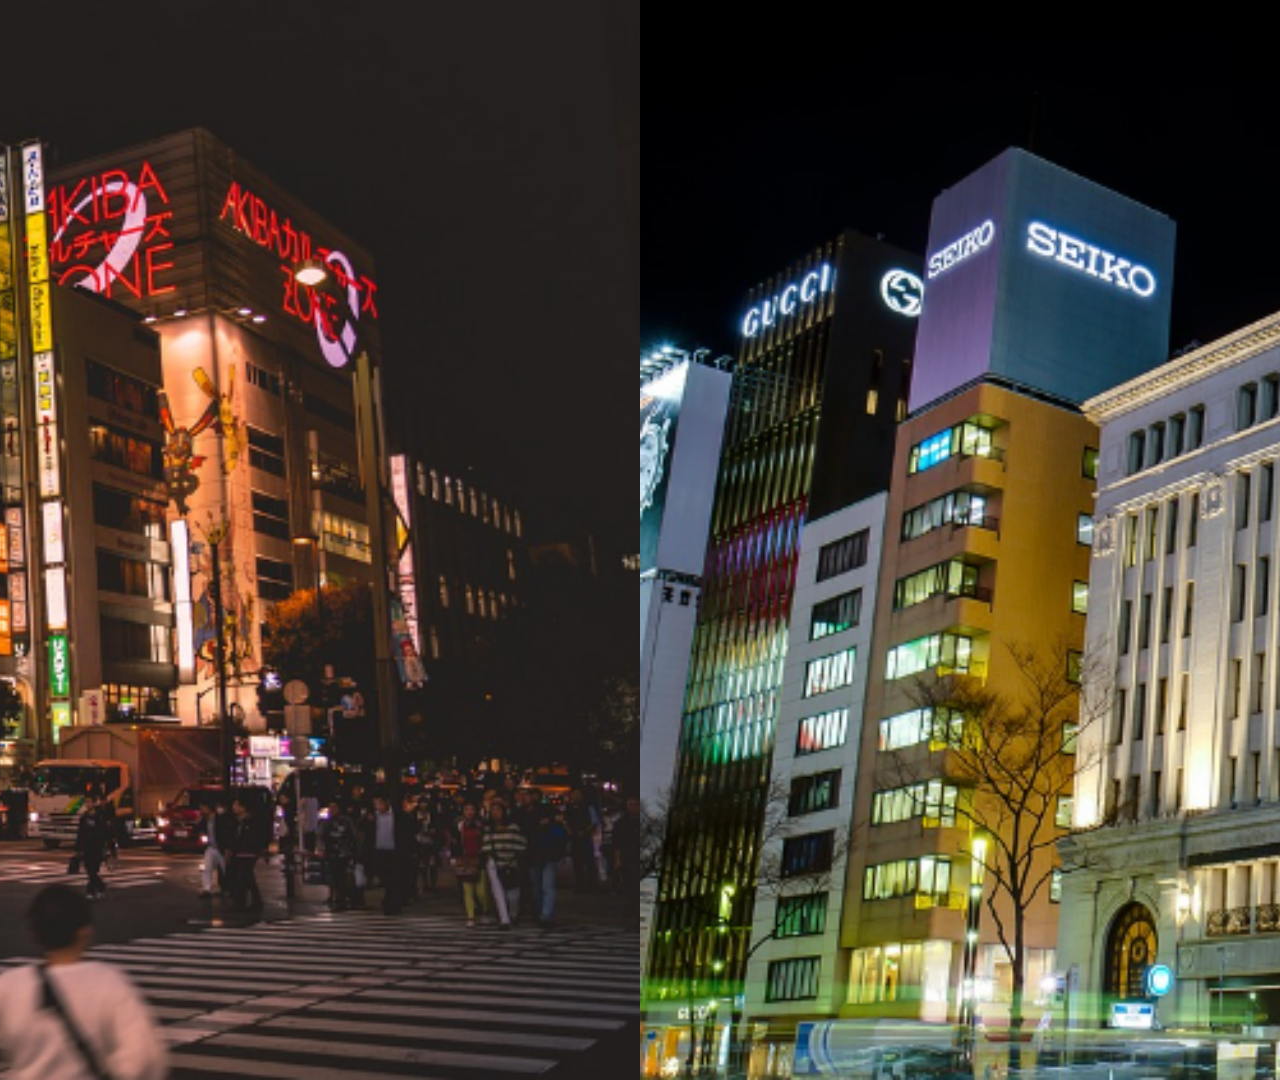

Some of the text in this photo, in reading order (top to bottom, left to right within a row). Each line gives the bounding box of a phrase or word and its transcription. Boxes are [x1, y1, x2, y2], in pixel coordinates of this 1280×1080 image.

[48, 211, 173, 264] ルチャーズ
[927, 219, 995, 279] SEIKO
[1026, 221, 1156, 298] SEIKO
[52, 242, 177, 300] ONE
[742, 263, 832, 337] GUCCI
